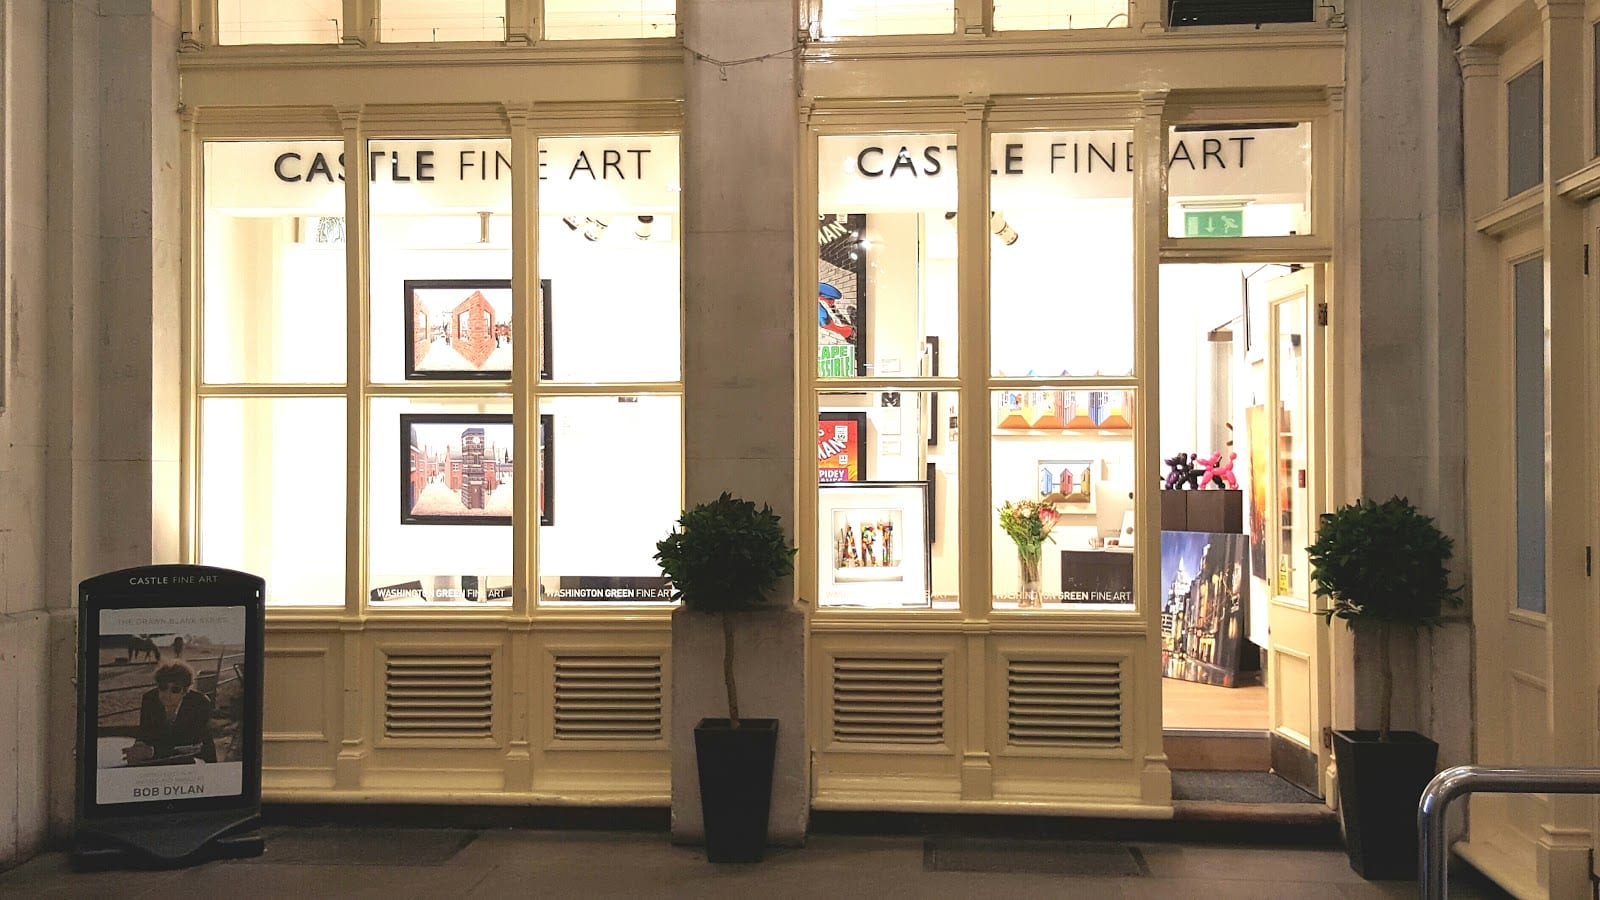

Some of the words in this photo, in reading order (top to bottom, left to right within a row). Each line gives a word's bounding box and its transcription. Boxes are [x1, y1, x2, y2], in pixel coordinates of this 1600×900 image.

[857, 144, 1023, 177] CASE
[1051, 142, 1134, 174] FINE
[1168, 137, 1255, 170] ART
[569, 150, 651, 180] ART
[129, 577, 168, 585] CASTLE
[173, 576, 195, 584] FINE
[198, 575, 218, 583] ART
[436, 588, 465, 598] GREEN
[487, 588, 505, 598] ART
[546, 588, 604, 598] WASHINGTON
[605, 588, 635, 598] GREEN
[636, 588, 656, 598] FINE
[1059, 591, 1089, 601] GREEN
[1091, 591, 1111, 601] FINE
[1113, 591, 1132, 601] ART
[133, 787, 160, 797] BOB
[163, 784, 204, 796] DYLAN
